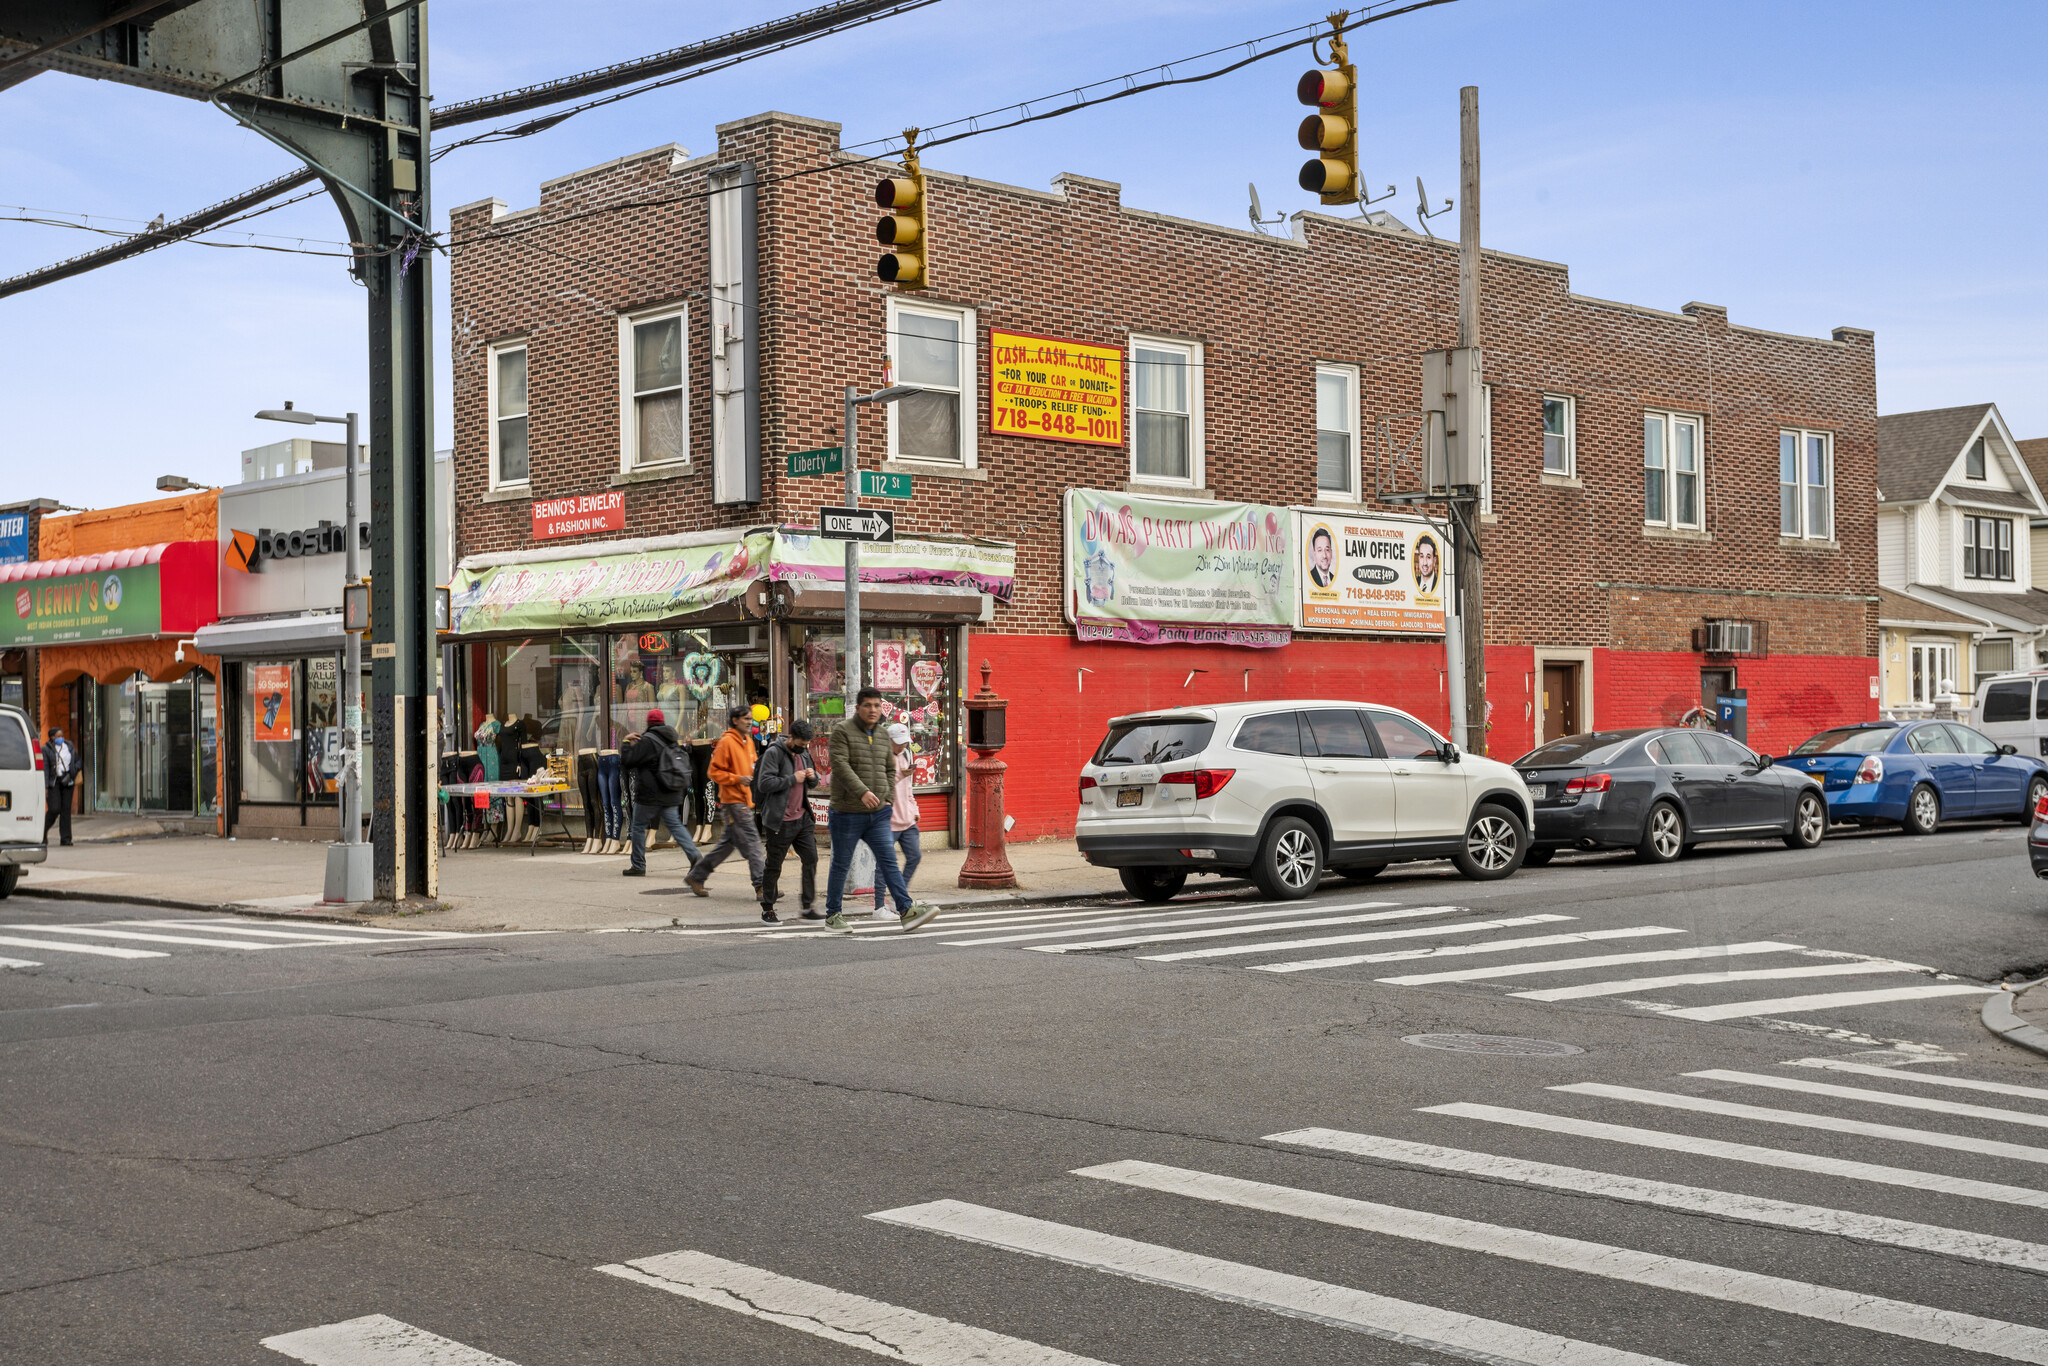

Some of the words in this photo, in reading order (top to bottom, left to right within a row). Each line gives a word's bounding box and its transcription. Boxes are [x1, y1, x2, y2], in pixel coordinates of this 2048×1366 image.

[1005, 368, 1021, 380] FOR
[1026, 371, 1046, 384] YOUR
[1051, 374, 1066, 387] CAR
[1080, 378, 1109, 392] DONATE
[1001, 382, 1013, 392] GET
[1014, 384, 1027, 394] TAX
[1028, 385, 1061, 398] DEDUCTION
[1063, 391, 1067, 400] &
[1069, 391, 1084, 401] FREE
[1086, 393, 1113, 406] VACATION
[1014, 397, 1047, 410] TROOPS
[1051, 402, 1079, 414] RELIEF
[1082, 406, 1103, 416] FUND
[997, 407, 1118, 439] 718-848-1011
[793, 453, 827, 474] Liberty
[829, 451, 837, 462] Av
[870, 475, 887, 495] 112
[892, 477, 900, 489] St
[535, 500, 576, 519] BENNO'S
[577, 491, 622, 514] JEWELRY
[548, 523, 554, 535] &
[555, 520, 591, 533] FASHION
[592, 517, 608, 530] INC.
[831, 517, 852, 531] ONE
[862, 519, 883, 532] WAY
[1143, 516, 1193, 549] PARTY
[1344, 526, 1359, 535] FREE
[1359, 527, 1404, 538] CONSULTATION
[1345, 539, 1367, 557] LAW
[1370, 542, 1405, 560] OFFICE
[1358, 568, 1382, 580] DIVORCE
[1382, 569, 1395, 581] $499
[36, 578, 99, 617] LENNY'S
[1346, 587, 1406, 602] 718-848-9595
[1314, 607, 1340, 615] PERSONAL
[1341, 608, 1359, 616] INJURY
[1367, 609, 1380, 617] REAL
[1380, 610, 1397, 618] ESTATE
[1403, 611, 1433, 619] IMMIGRATION
[1307, 617, 1331, 625] WORKERS
[1332, 618, 1346, 626] COMP
[1352, 619, 1374, 627] CRIMINAL
[1400, 621, 1423, 629] LANDLORD
[1081, 625, 1114, 639] 112-02
[1158, 628, 1189, 642] Party
[1194, 629, 1228, 641] World
[316, 662, 335, 671] BES
[267, 680, 288, 690] Speed
[1725, 707, 1732, 719] P
